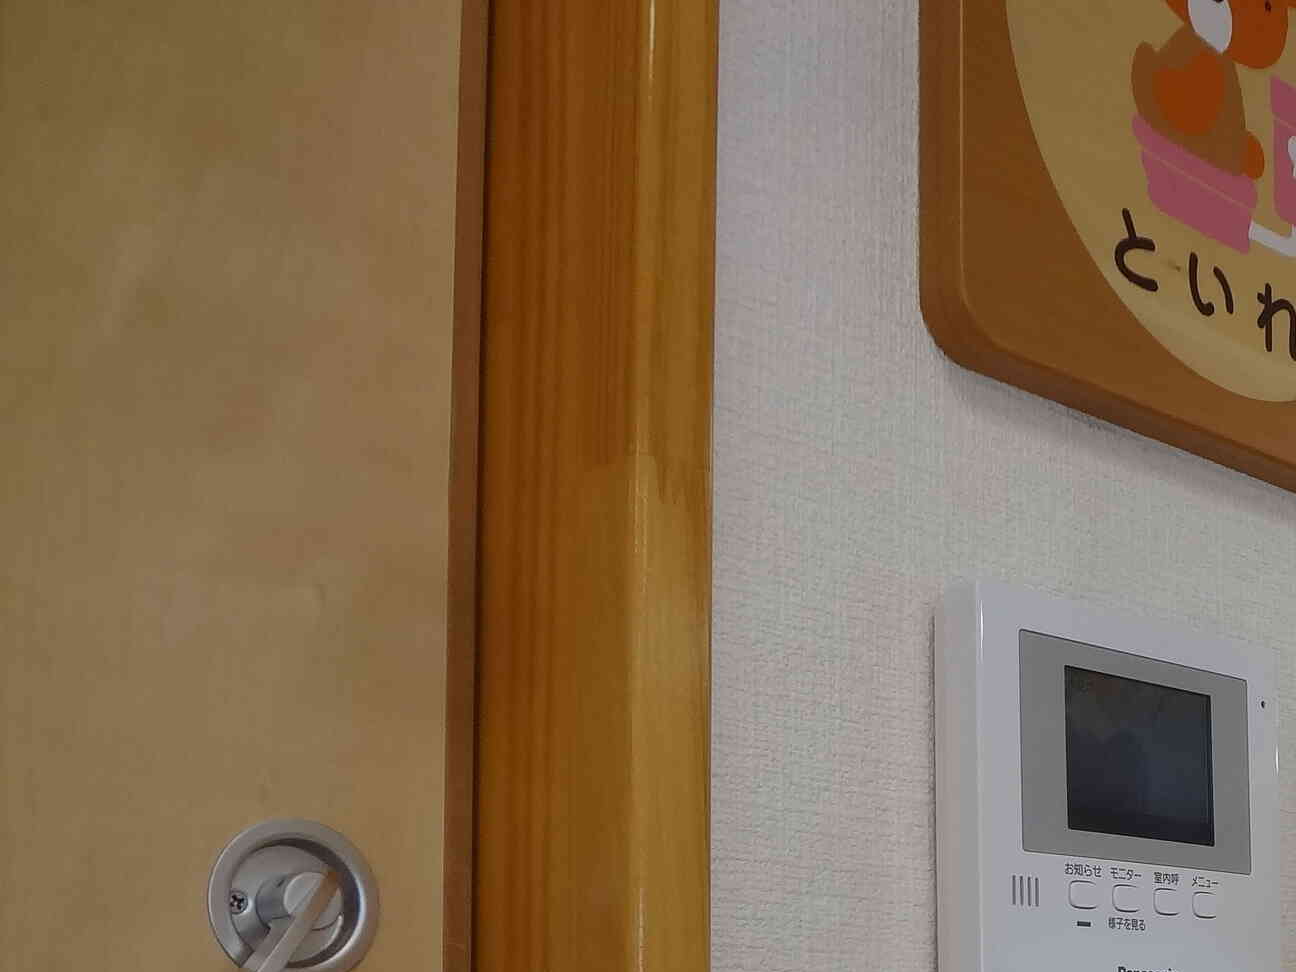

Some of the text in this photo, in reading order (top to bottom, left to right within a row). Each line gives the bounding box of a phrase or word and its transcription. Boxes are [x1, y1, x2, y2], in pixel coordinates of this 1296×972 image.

[1064, 863, 1102, 878] お知らせ
[1110, 867, 1142, 881] モニター
[1153, 871, 1180, 886] 室内呼
[1192, 876, 1219, 888] メニュー
[1108, 917, 1146, 931] 様子を見る
